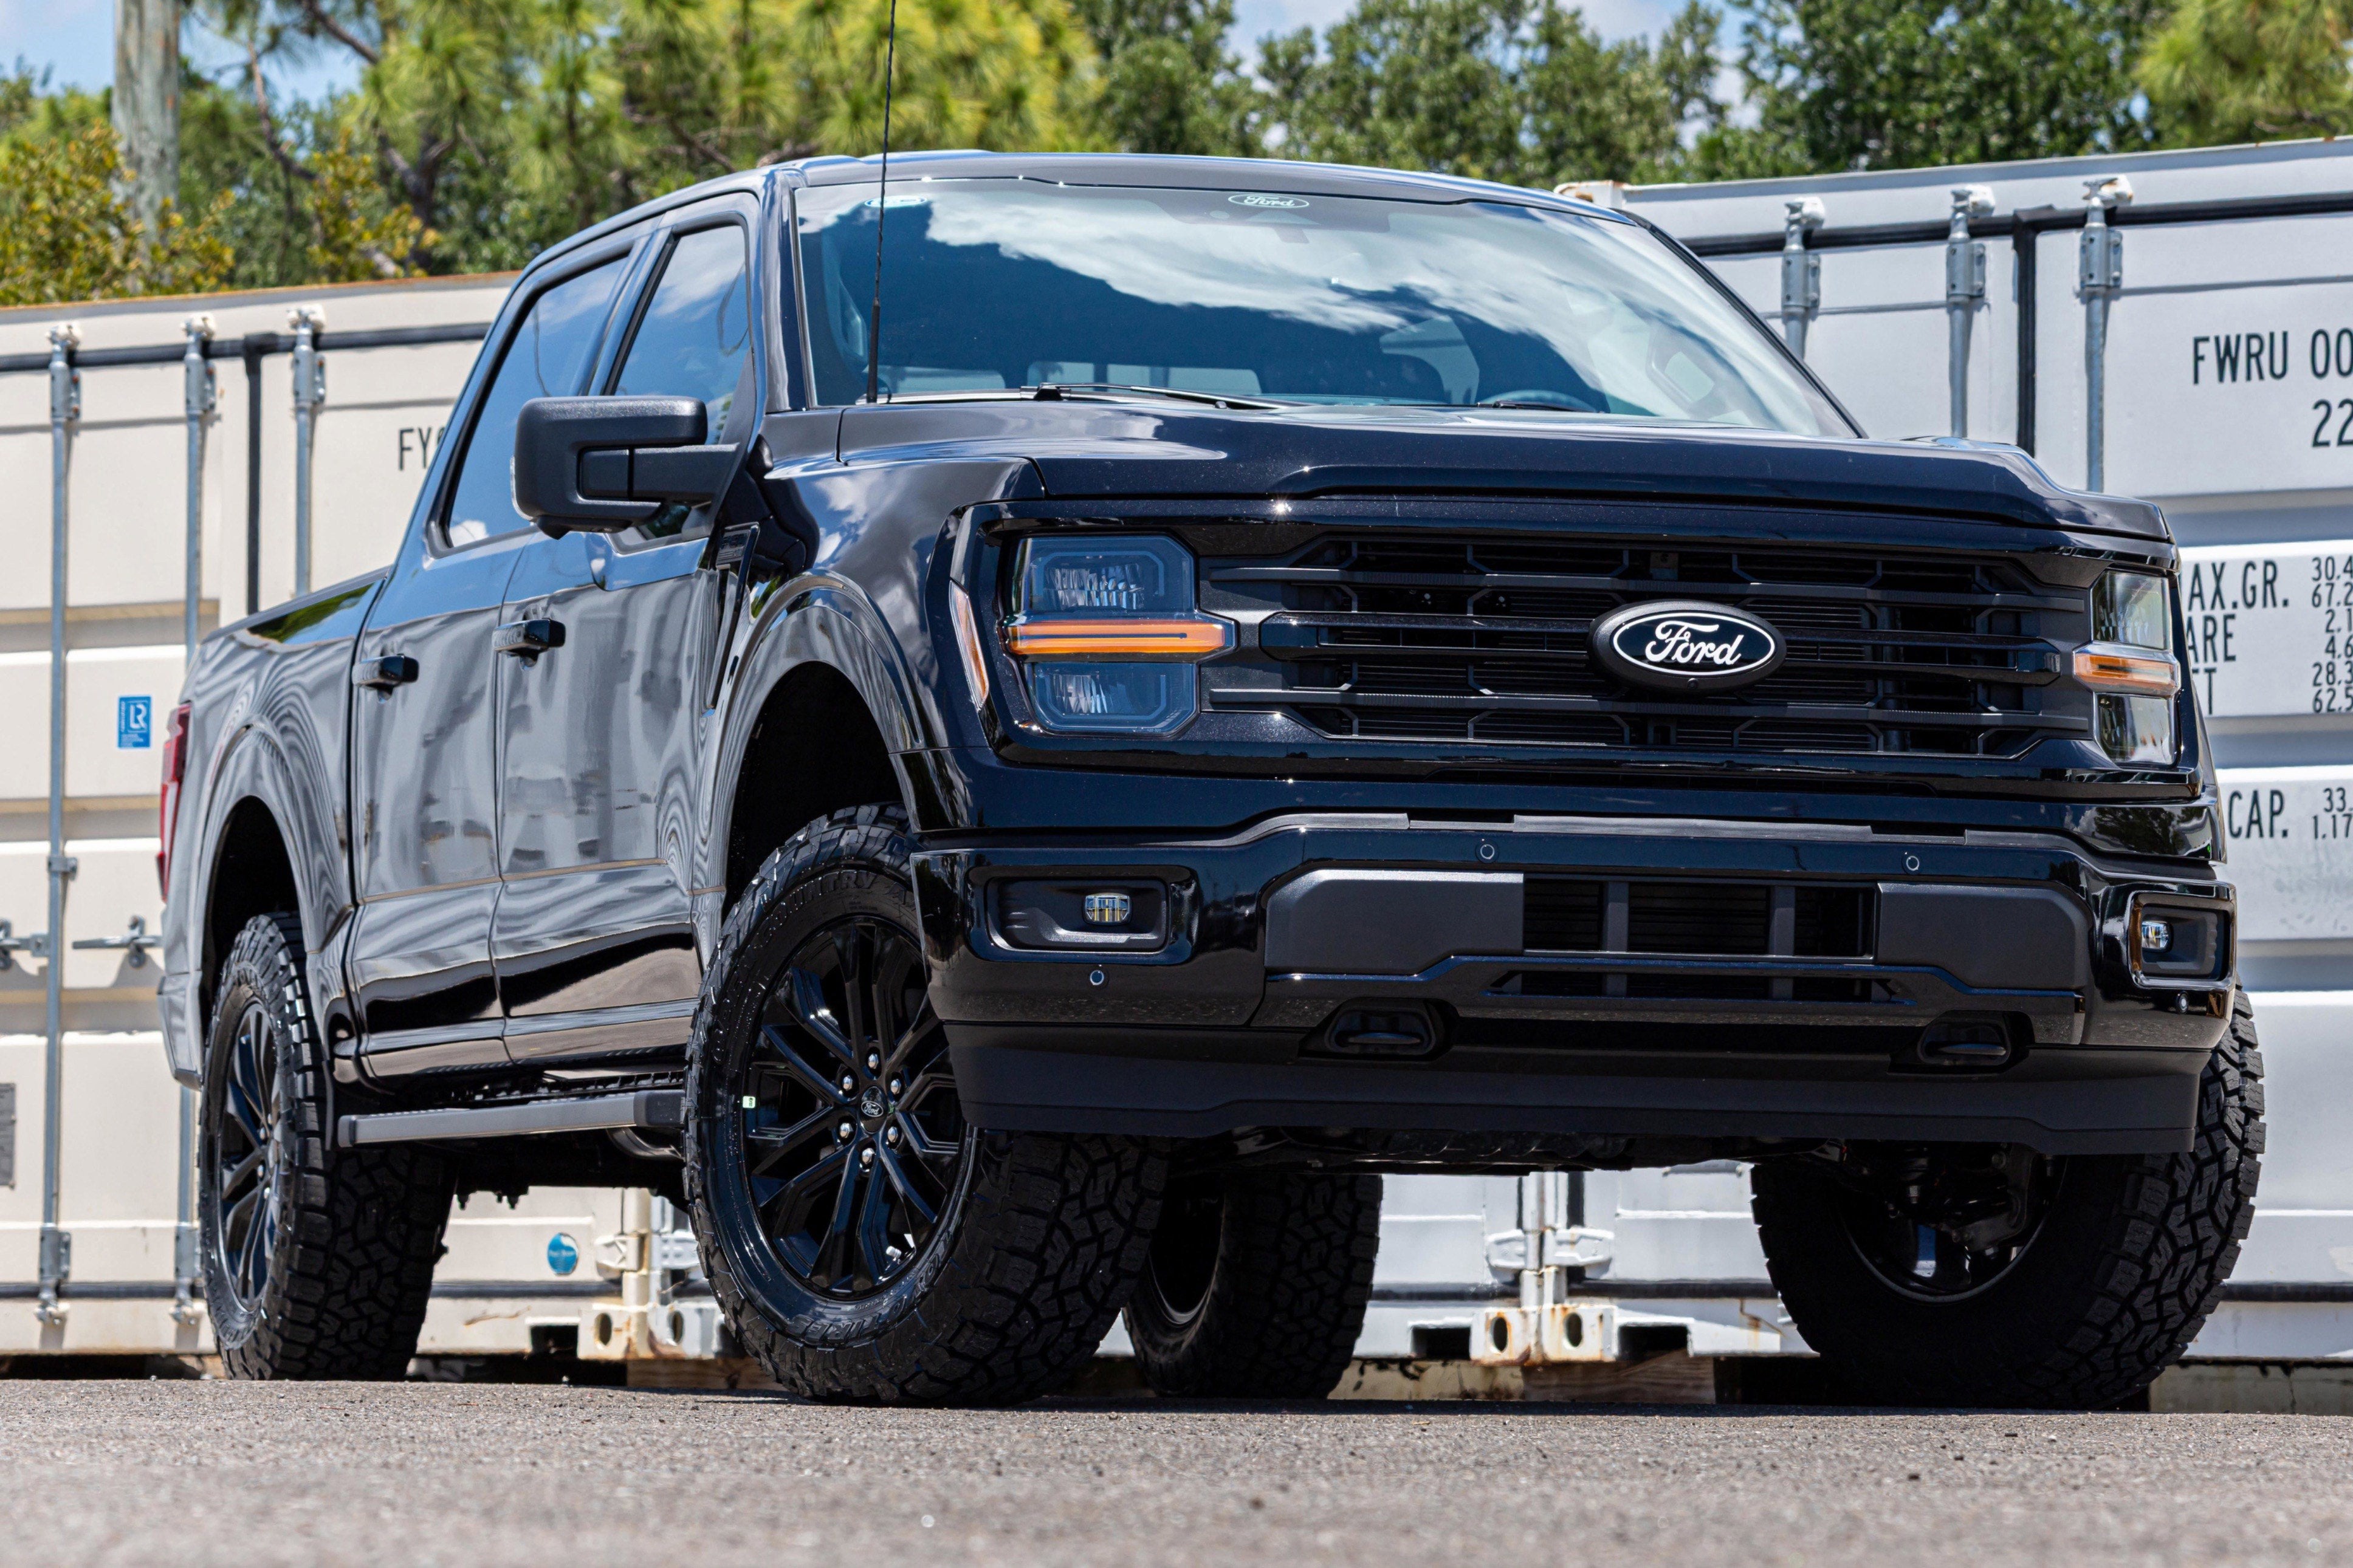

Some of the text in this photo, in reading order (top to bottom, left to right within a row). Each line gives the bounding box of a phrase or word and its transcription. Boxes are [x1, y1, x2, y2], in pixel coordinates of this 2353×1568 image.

[1244, 196, 1295, 207] Ford
[2193, 327, 2353, 385] FWRU 00
[2312, 398, 2353, 448] 22
[2178, 560, 2289, 611] AX.GR.
[1645, 620, 1744, 665] Ford
[2186, 613, 2236, 663] ARE
